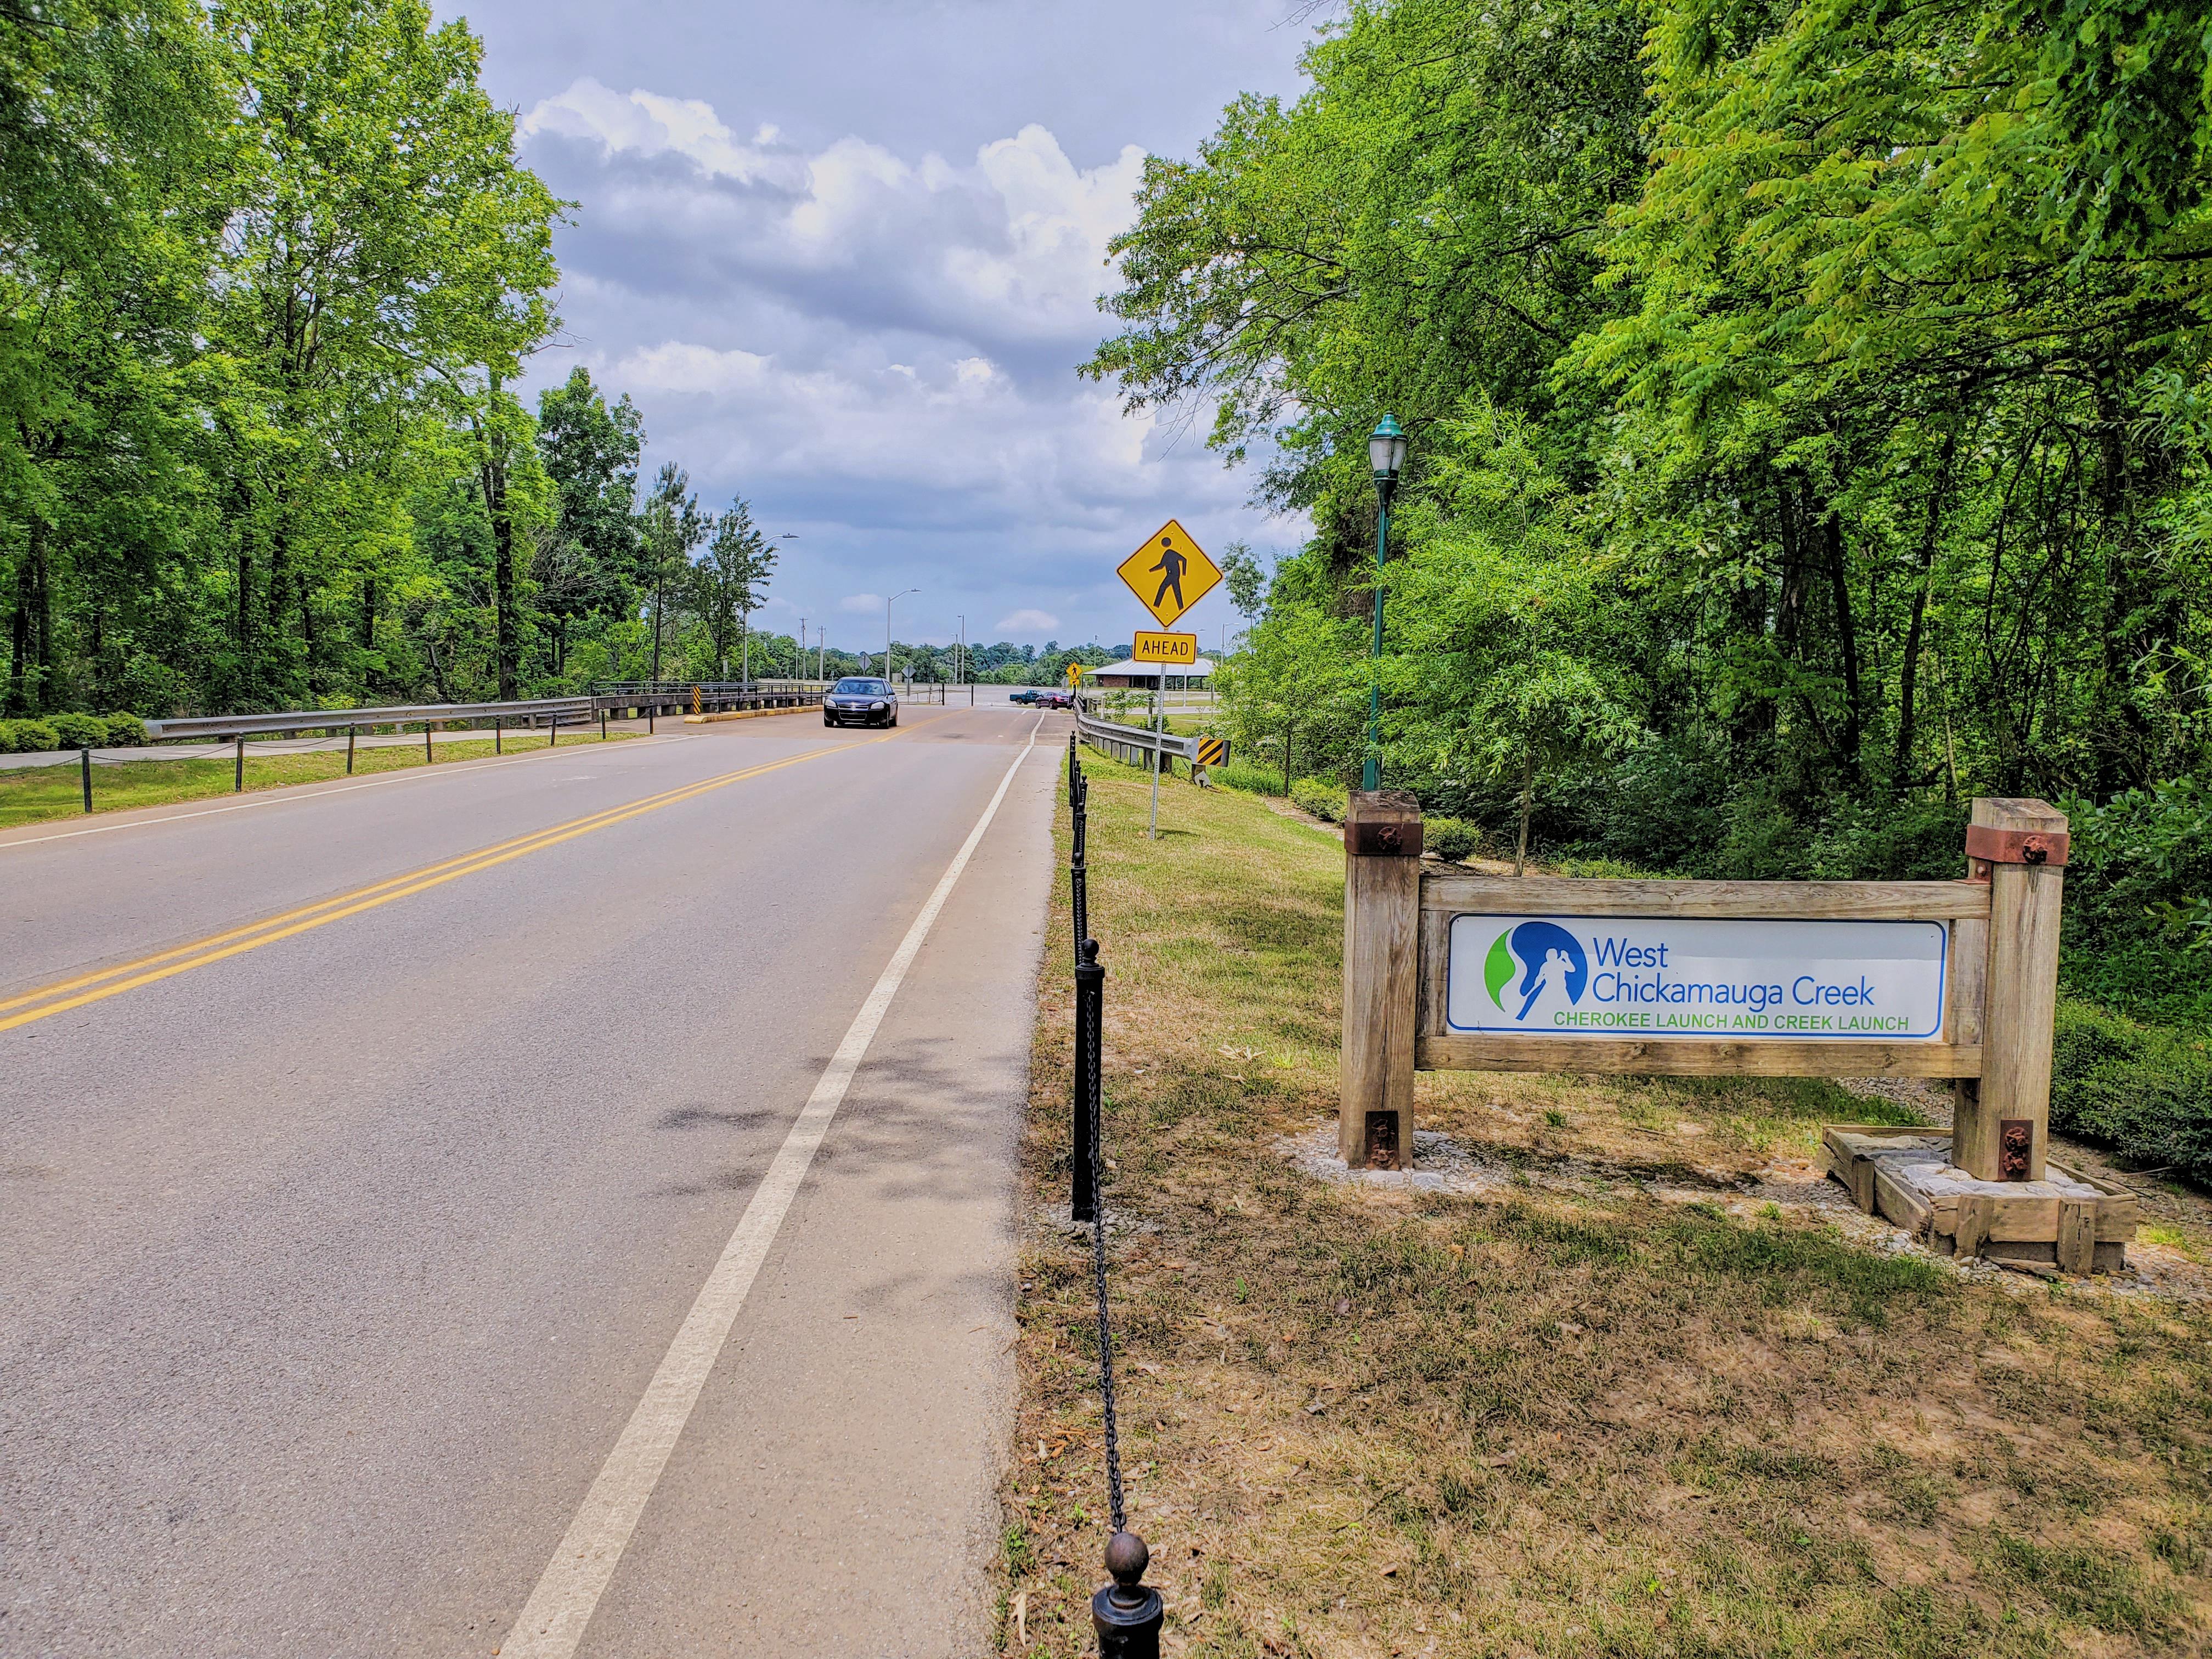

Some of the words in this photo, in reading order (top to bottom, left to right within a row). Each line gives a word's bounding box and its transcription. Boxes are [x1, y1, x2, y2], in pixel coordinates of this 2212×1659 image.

[1142, 640, 1188, 656] AHEAD
[1593, 938, 1668, 968] West
[1593, 972, 1782, 1013] Chickamauga
[1792, 975, 1875, 1006] Creek
[1554, 1011, 1651, 1028] CHEROKEE
[1656, 1014, 1728, 1029] LAUNCH
[1731, 1015, 1769, 1029] AND
[1773, 1015, 1833, 1030] CREEK
[1838, 1016, 1909, 1031] LAUNCH
